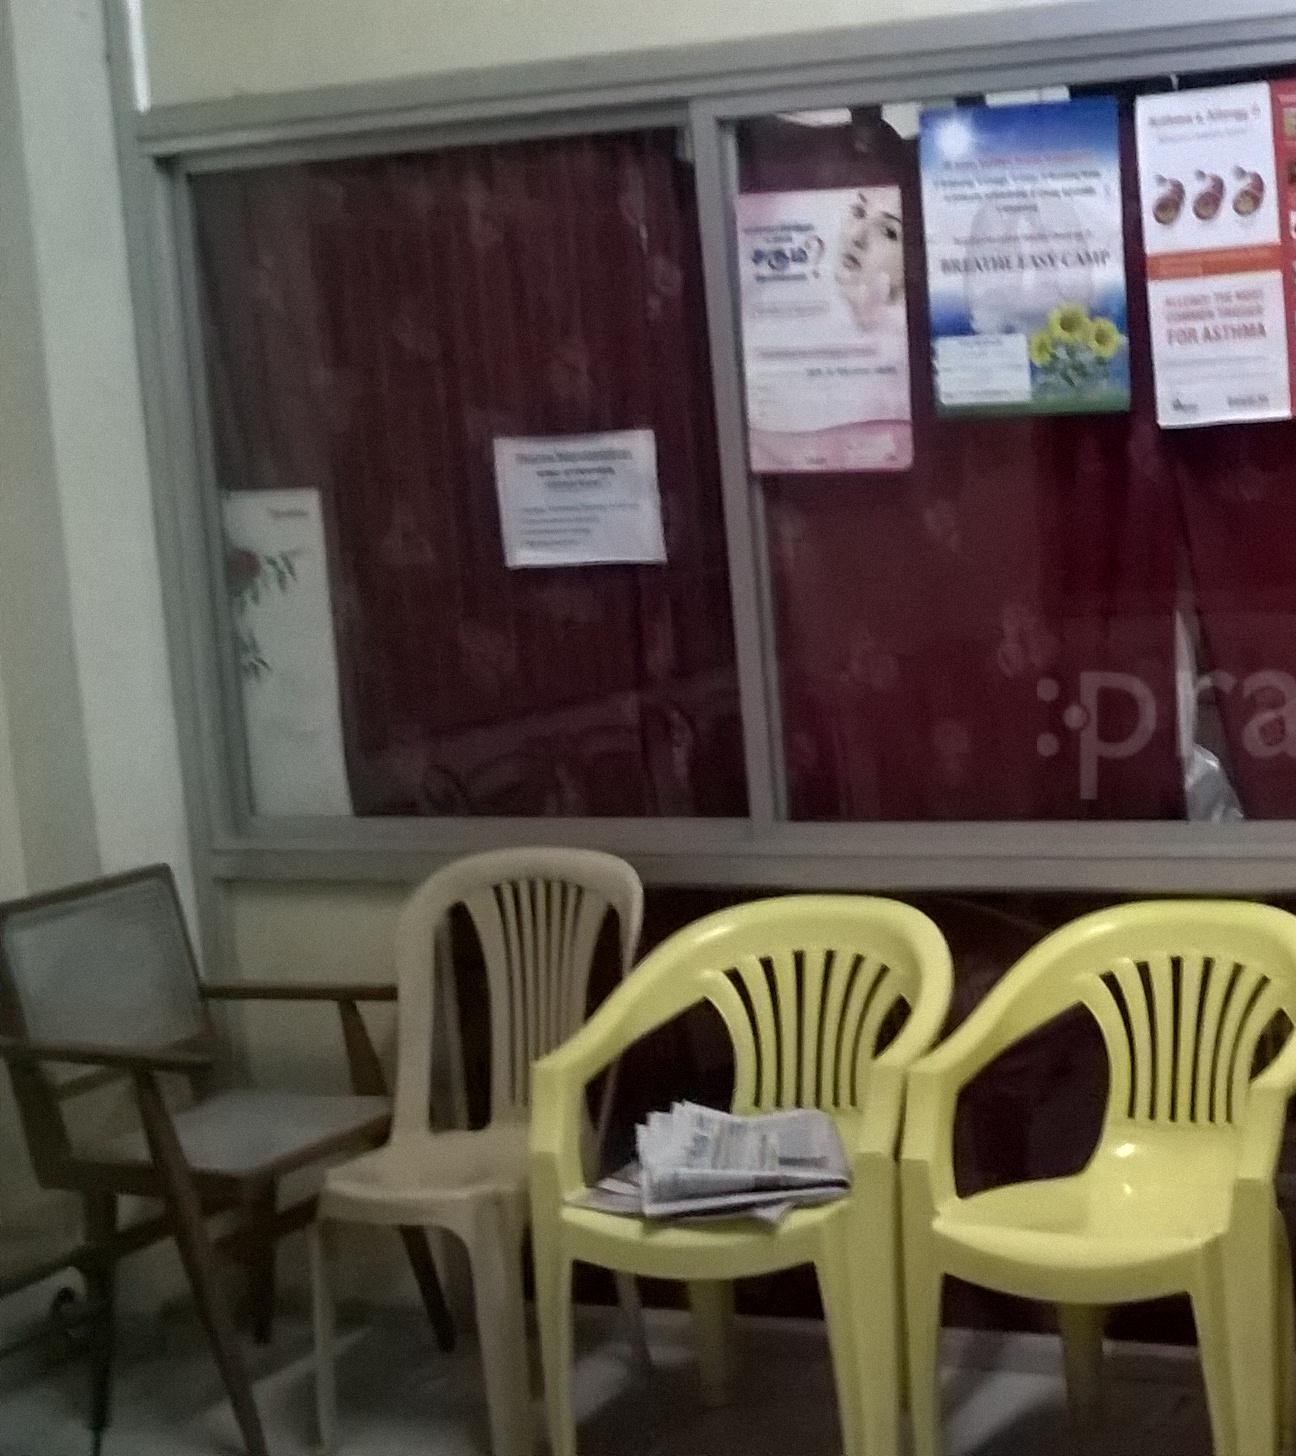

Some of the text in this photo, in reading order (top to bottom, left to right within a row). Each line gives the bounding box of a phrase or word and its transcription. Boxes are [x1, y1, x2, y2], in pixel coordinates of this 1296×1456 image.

[940, 248, 1111, 274] BREATHE EASY CAMP
[1166, 321, 1267, 346] FOR ASTHMA
